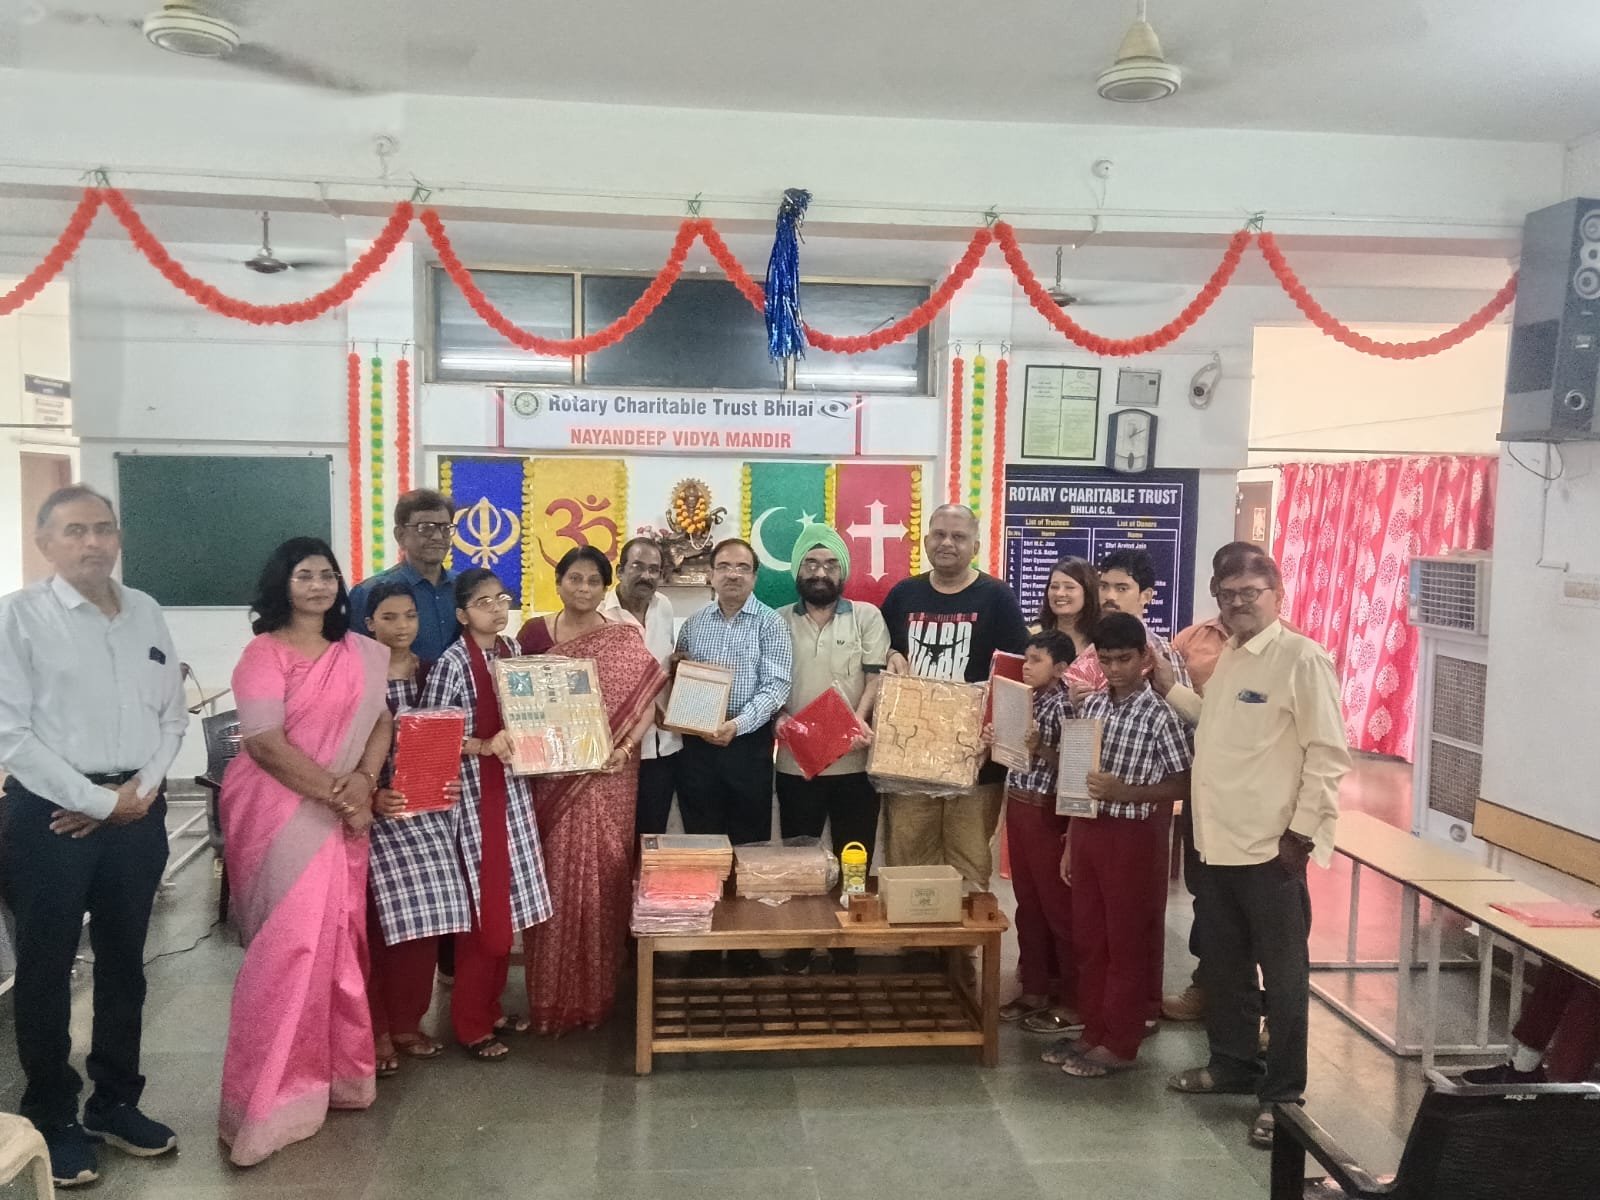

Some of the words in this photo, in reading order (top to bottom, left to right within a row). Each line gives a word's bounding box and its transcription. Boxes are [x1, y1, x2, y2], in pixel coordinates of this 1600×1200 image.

[549, 395, 607, 415] Rotary
[614, 396, 706, 415] Charitable
[713, 399, 757, 416] Trust
[764, 400, 813, 416] Bhilai
[571, 428, 667, 446] NAYANDEEP
[673, 431, 720, 447] VIDYA
[726, 432, 791, 448] MANDIR
[1009, 487, 1056, 501] ROTARY
[1060, 488, 1135, 504] CHARITABLE
[1138, 489, 1178, 504] TRUST
[1070, 505, 1097, 514] BHILAI
[908, 620, 973, 657] HARD
